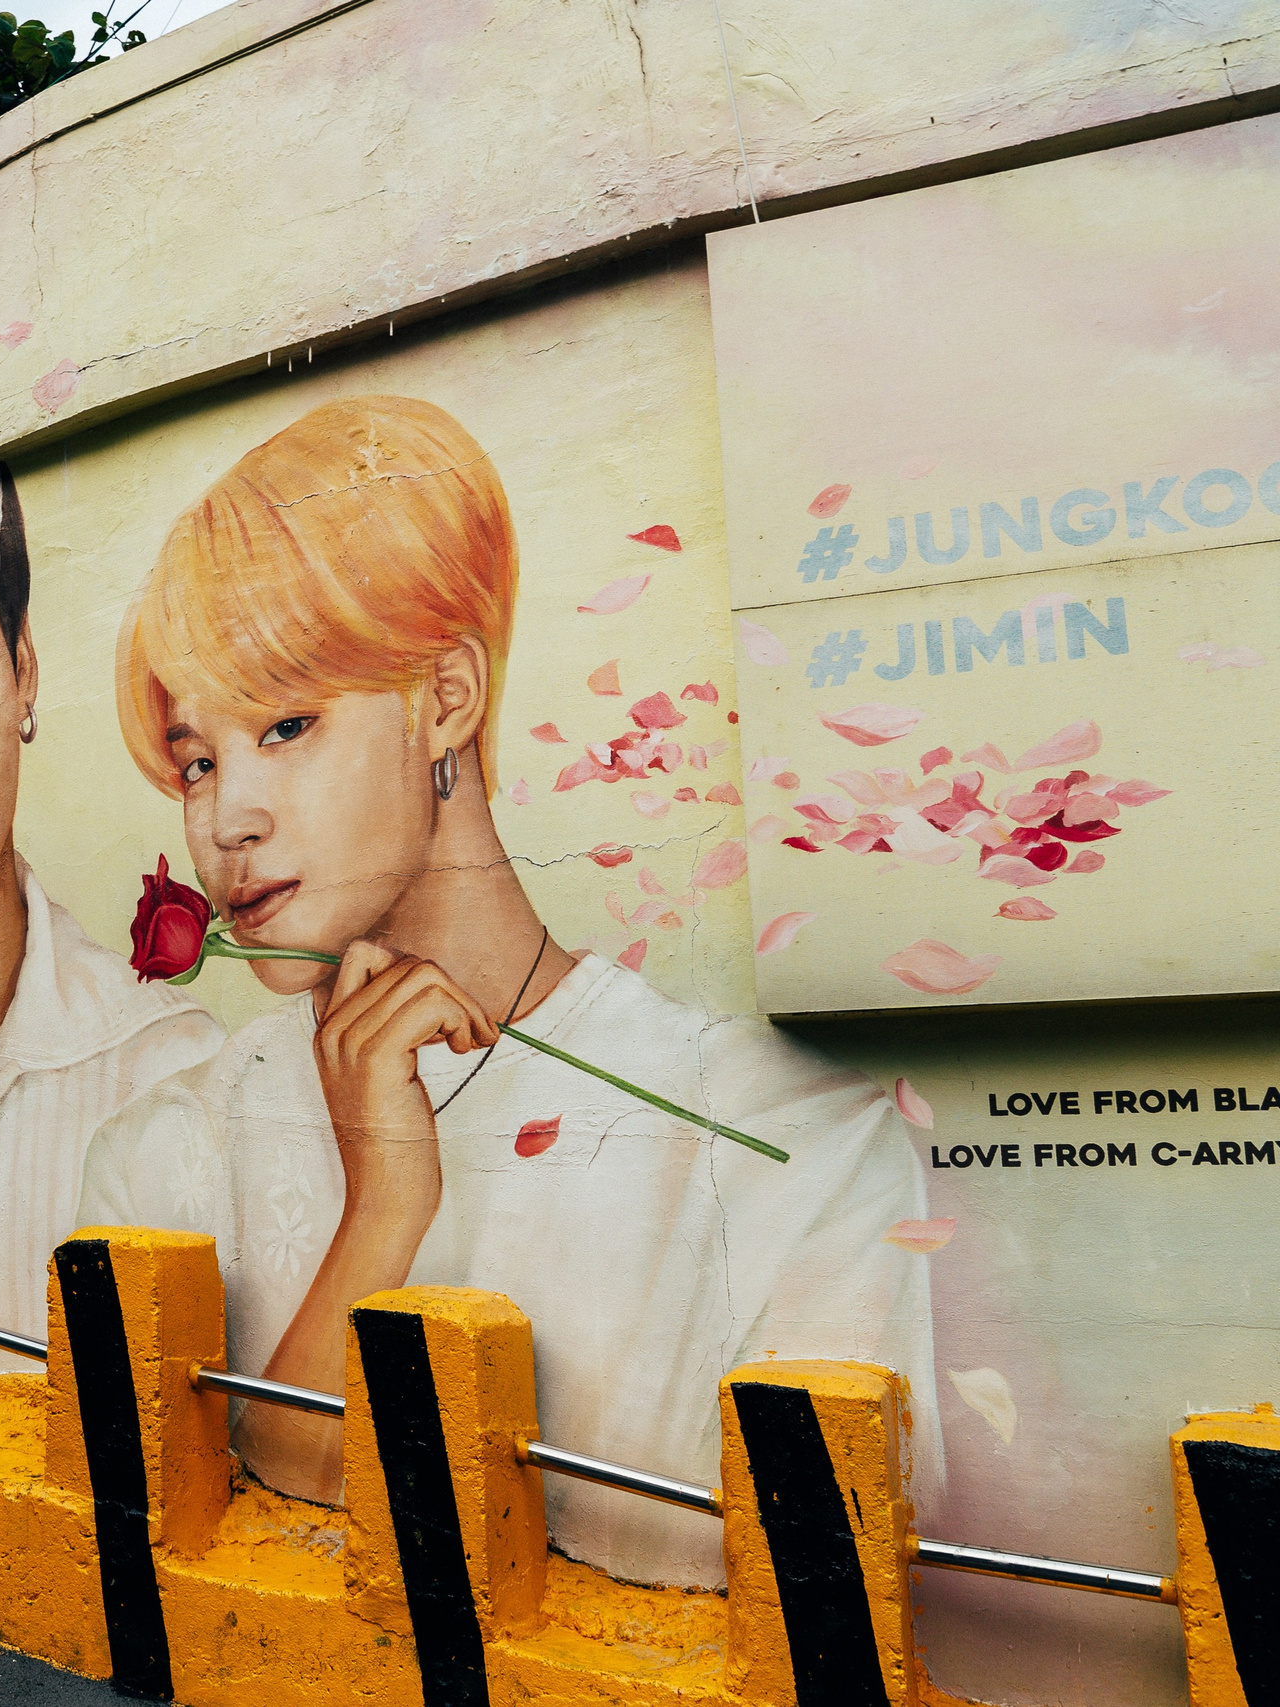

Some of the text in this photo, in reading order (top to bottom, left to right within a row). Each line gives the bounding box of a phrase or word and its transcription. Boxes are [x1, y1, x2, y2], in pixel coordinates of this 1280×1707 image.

[805, 597, 1129, 689] #JIMIN
[989, 1091, 1080, 1116] LOVE
[1093, 1089, 1199, 1114] FROM
[931, 1144, 1021, 1168] LOVE
[1034, 1143, 1137, 1167] FROM
